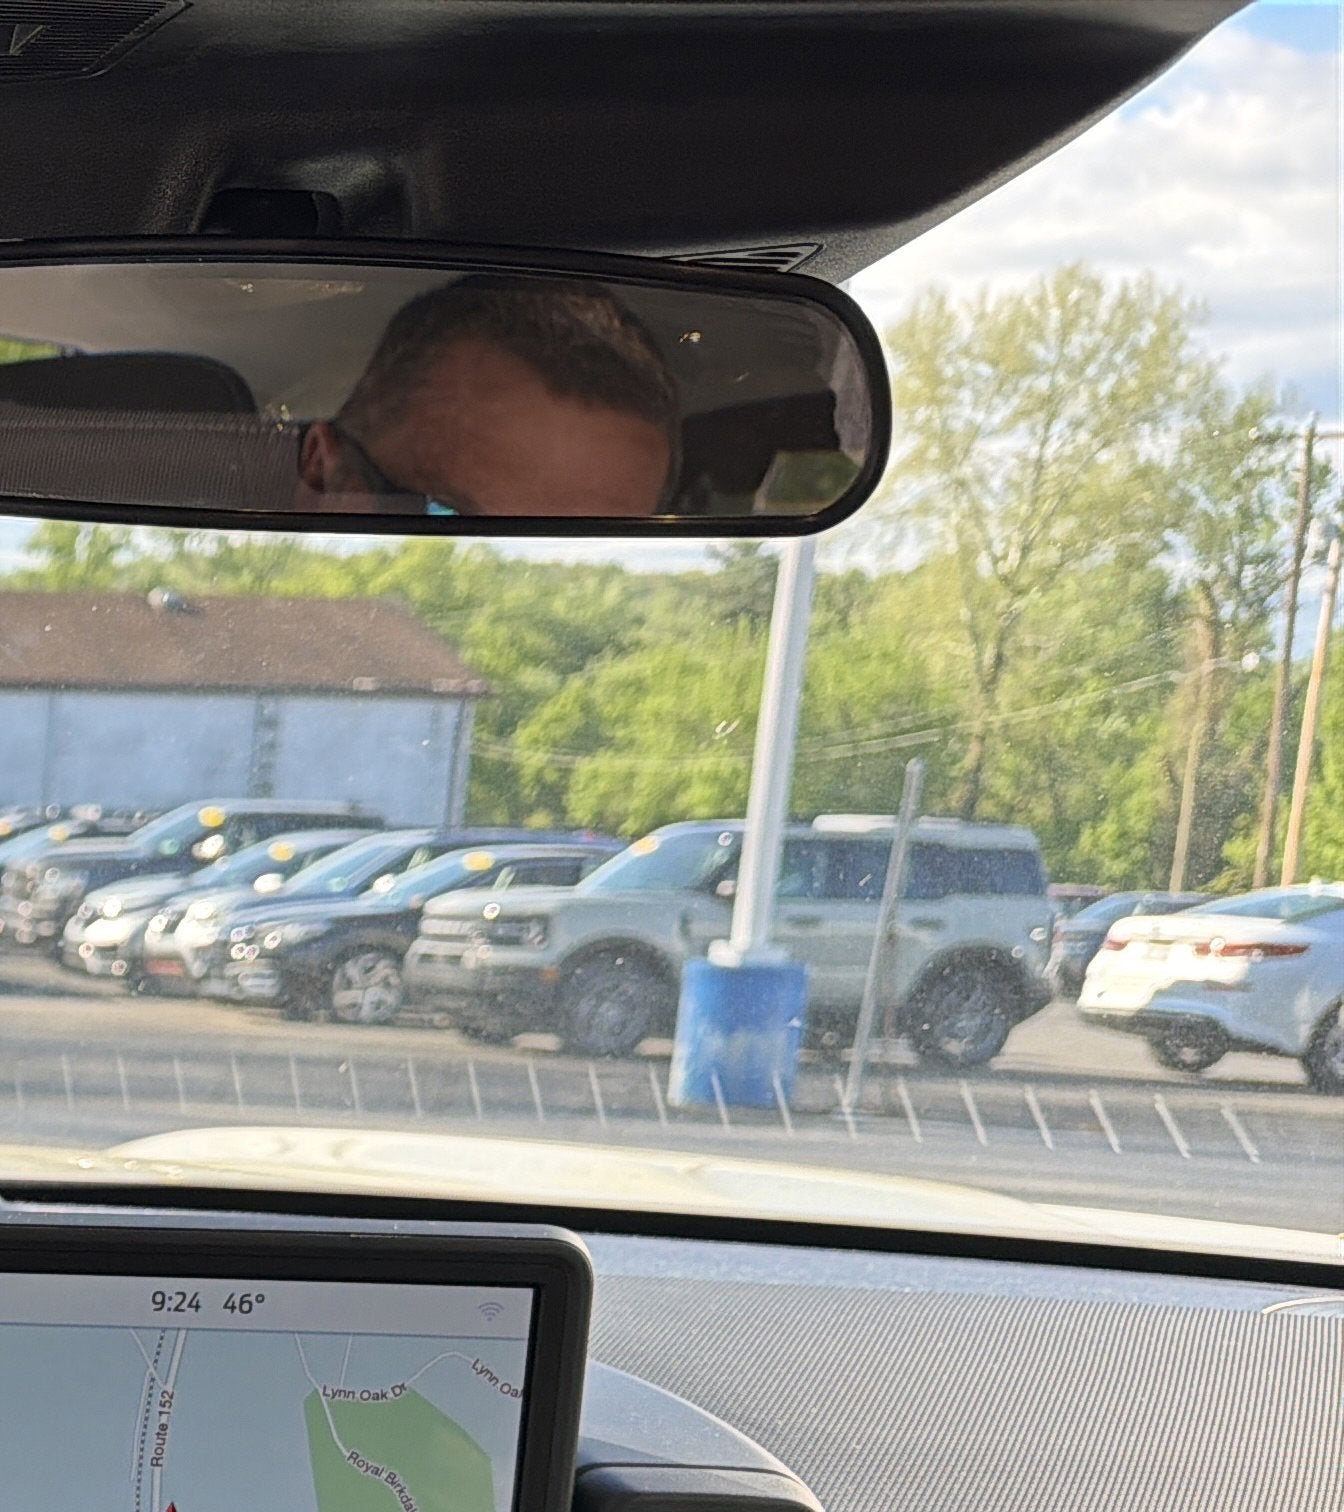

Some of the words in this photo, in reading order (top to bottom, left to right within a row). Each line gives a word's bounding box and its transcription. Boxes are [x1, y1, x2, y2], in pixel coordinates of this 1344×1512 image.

[151, 1290, 201, 1313] 9:24
[222, 1292, 266, 1315] 46°
[471, 1358, 499, 1387] Lynn
[158, 1388, 175, 1418] 152
[322, 1385, 356, 1400] Lynn
[359, 1388, 388, 1401] Oak
[390, 1382, 407, 1398] Dr
[150, 1421, 169, 1468] Route
[346, 1450, 385, 1478] Royal
